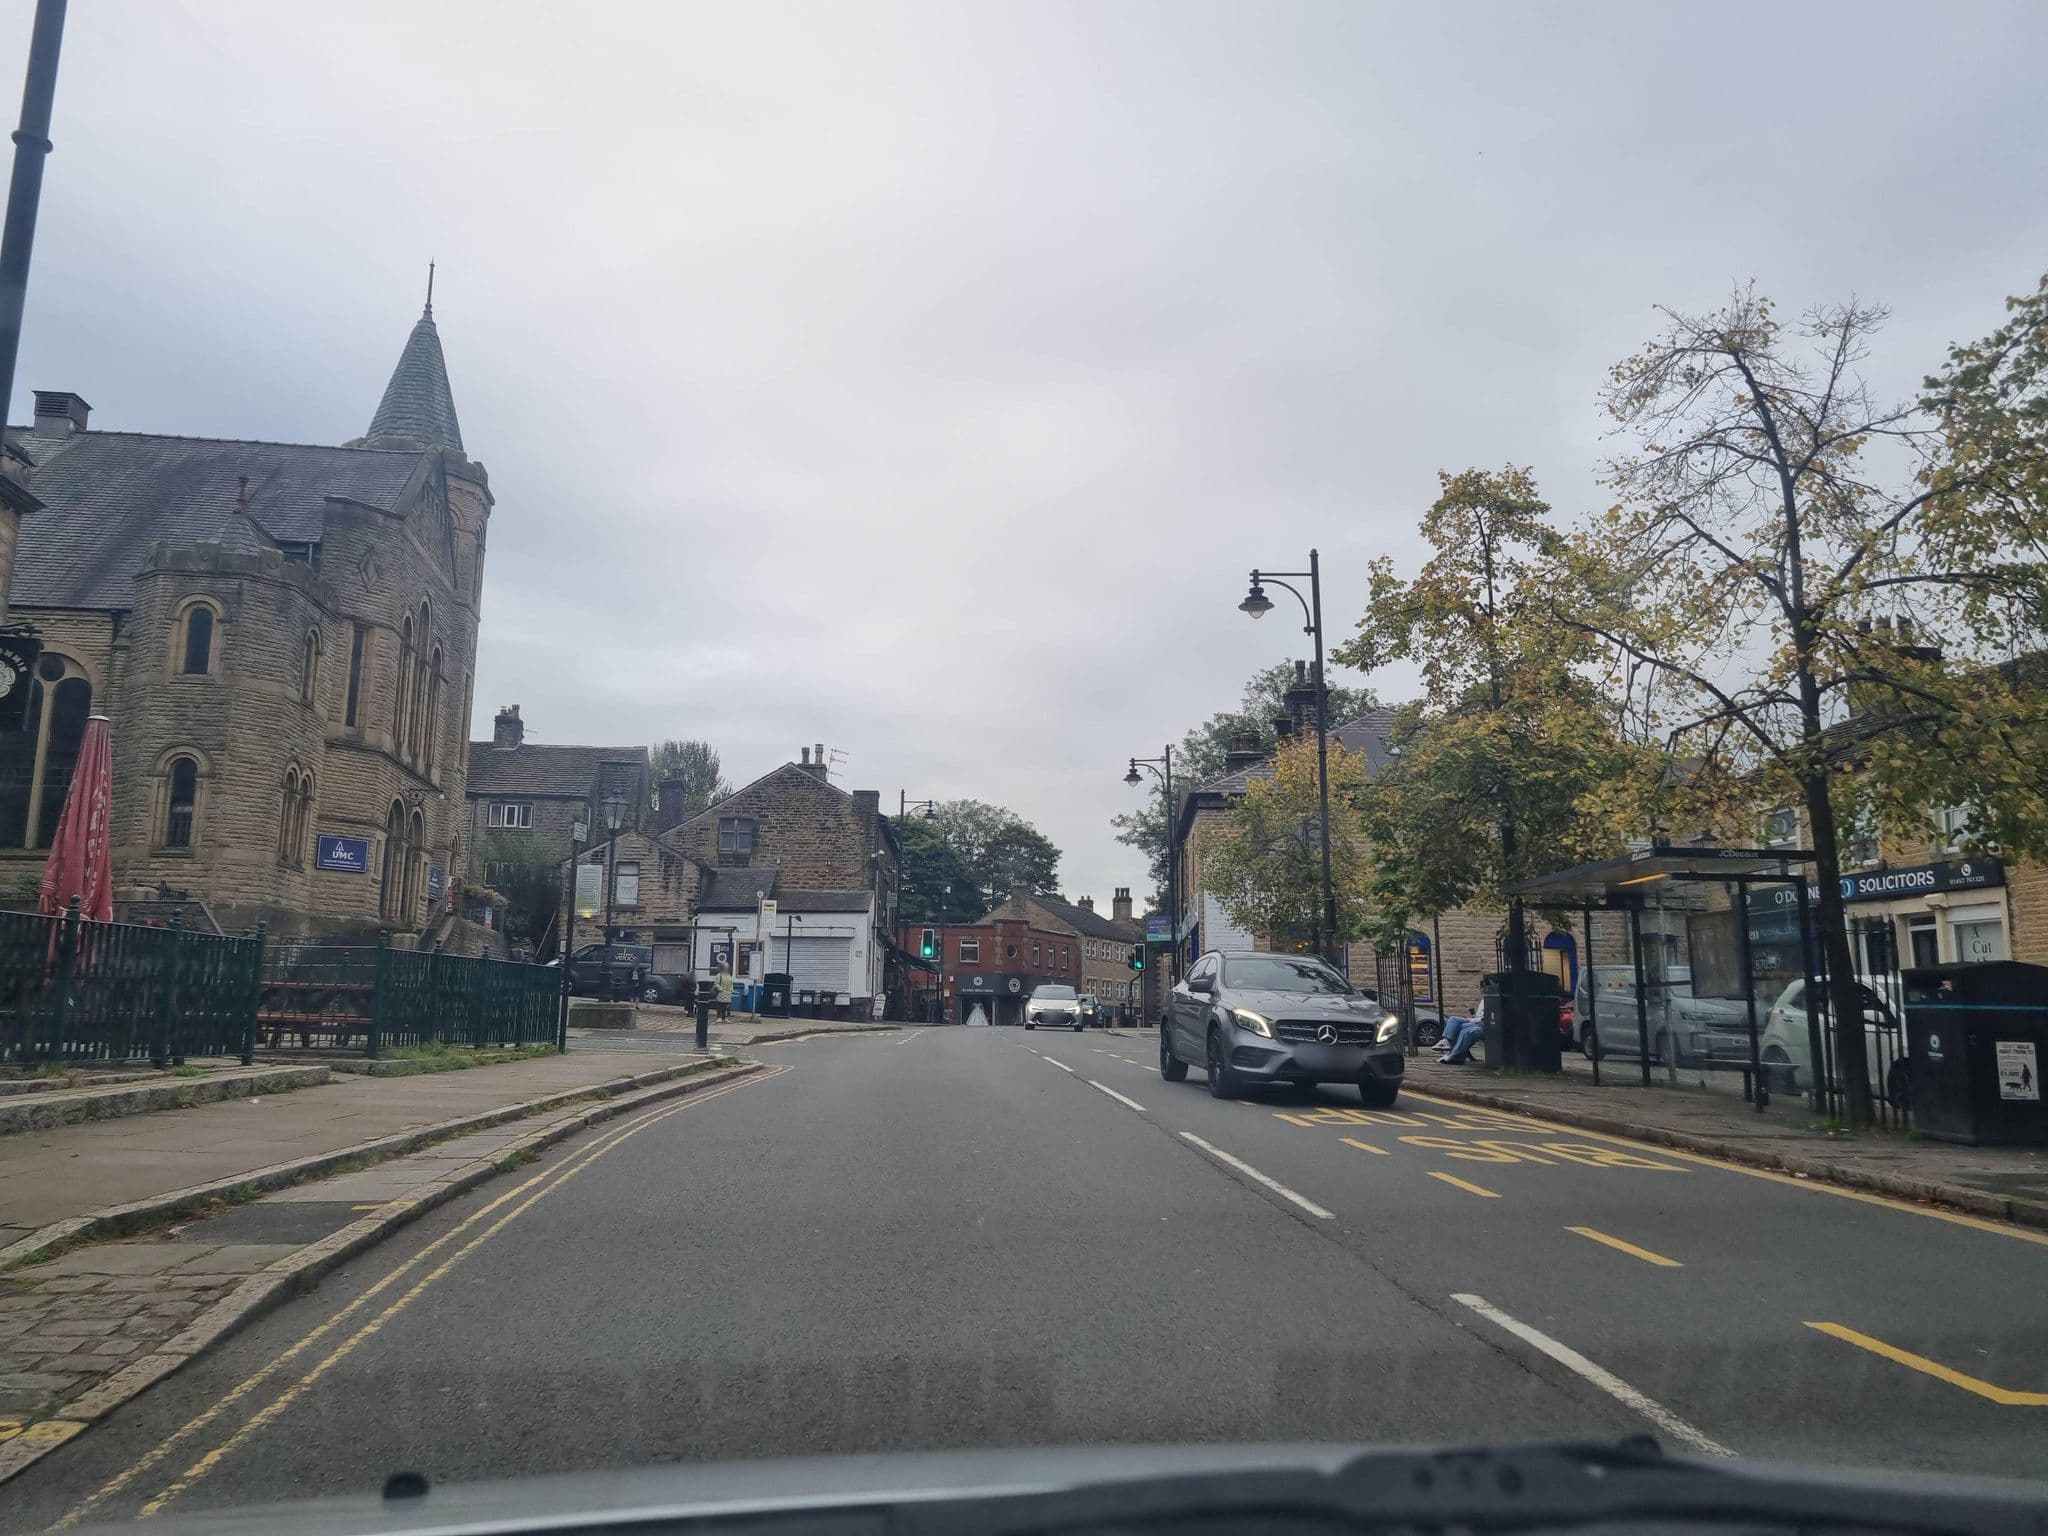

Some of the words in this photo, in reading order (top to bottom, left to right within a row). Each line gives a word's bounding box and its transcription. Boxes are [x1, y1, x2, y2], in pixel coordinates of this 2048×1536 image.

[332, 850, 355, 860] UMC
[1859, 870, 1935, 893] SOLICITORS
[1972, 940, 1992, 954] Cut
[1298, 1107, 1559, 1134] STOP
[1398, 1135, 1692, 1172] BUS
